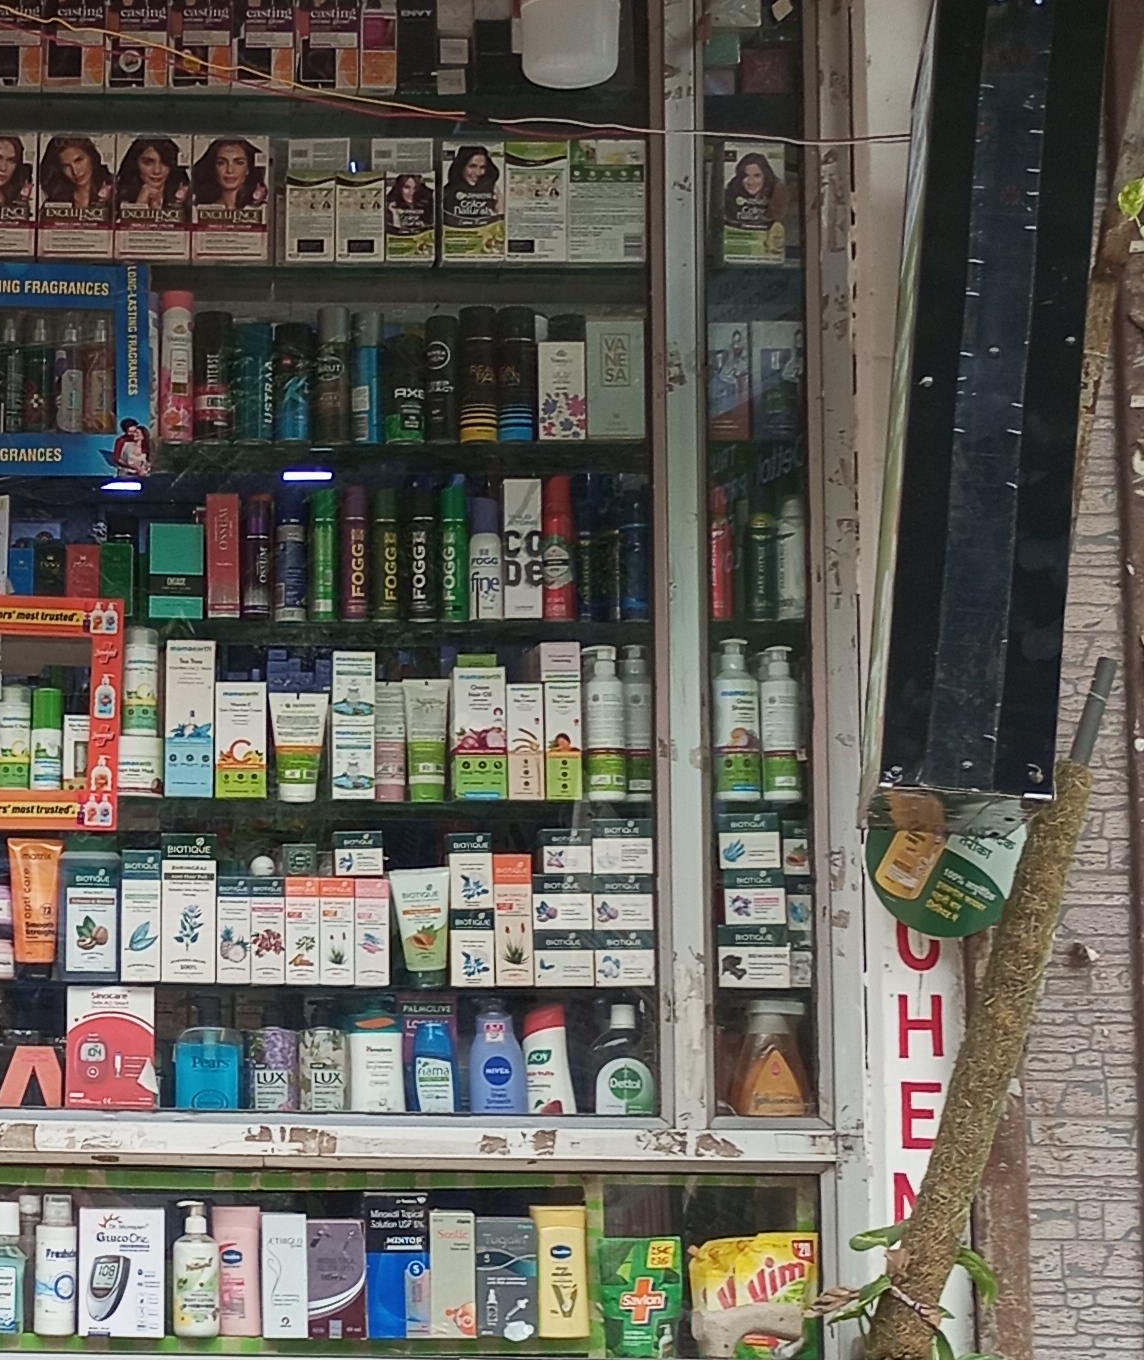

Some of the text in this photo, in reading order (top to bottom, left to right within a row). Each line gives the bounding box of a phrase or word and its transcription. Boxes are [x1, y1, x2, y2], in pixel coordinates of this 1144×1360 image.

[24, 280, 110, 297] FRAGRANCES
[393, 388, 425, 400] AXE
[17, 611, 40, 621] most
[11, 806, 35, 816] most
[167, 844, 212, 855] BIOTIQUE
[527, 1051, 549, 1062] JOY
[256, 1072, 287, 1085] LUX
[313, 1072, 343, 1085] LUX
[609, 1077, 642, 1090] Dettol
[747, 1256, 806, 1304] Vim
[621, 1293, 663, 1307] Savlon
